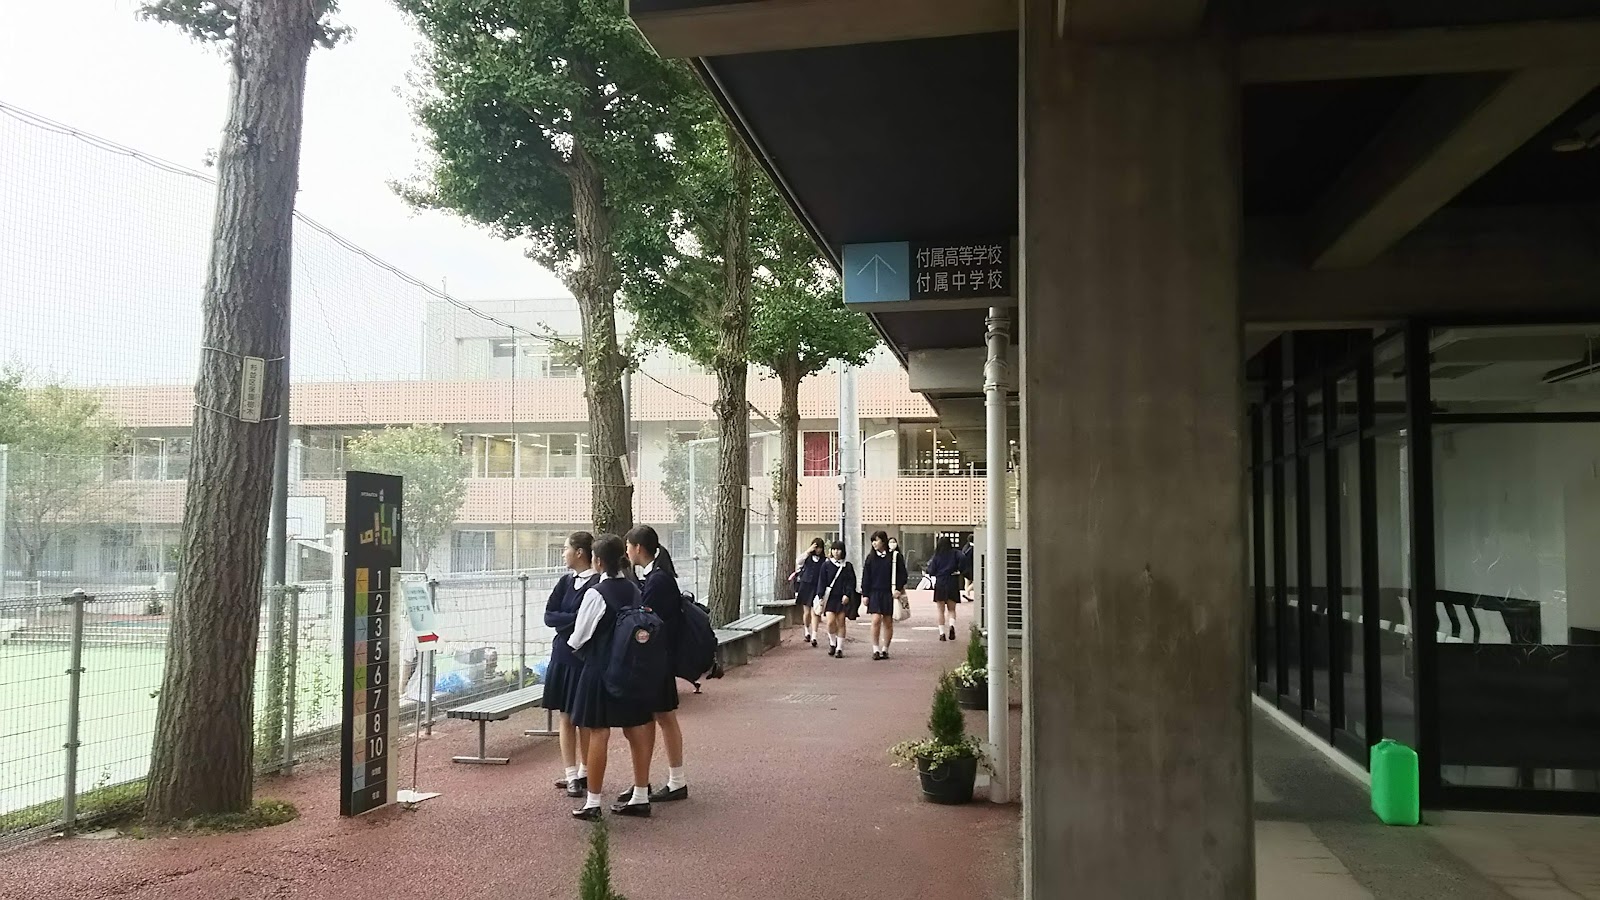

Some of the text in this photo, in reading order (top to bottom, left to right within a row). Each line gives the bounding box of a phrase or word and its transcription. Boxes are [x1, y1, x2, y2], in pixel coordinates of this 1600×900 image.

[916, 244, 1002, 268] 付属高等学校
[916, 269, 1002, 293] 付属中学校
[377, 570, 382, 589] 1
[375, 593, 383, 613] 2
[374, 617, 382, 637] 3
[374, 641, 382, 660] 5
[374, 665, 382, 685] 6
[373, 689, 381, 709] 7
[373, 713, 381, 733] 8
[370, 737, 383, 758] 10
